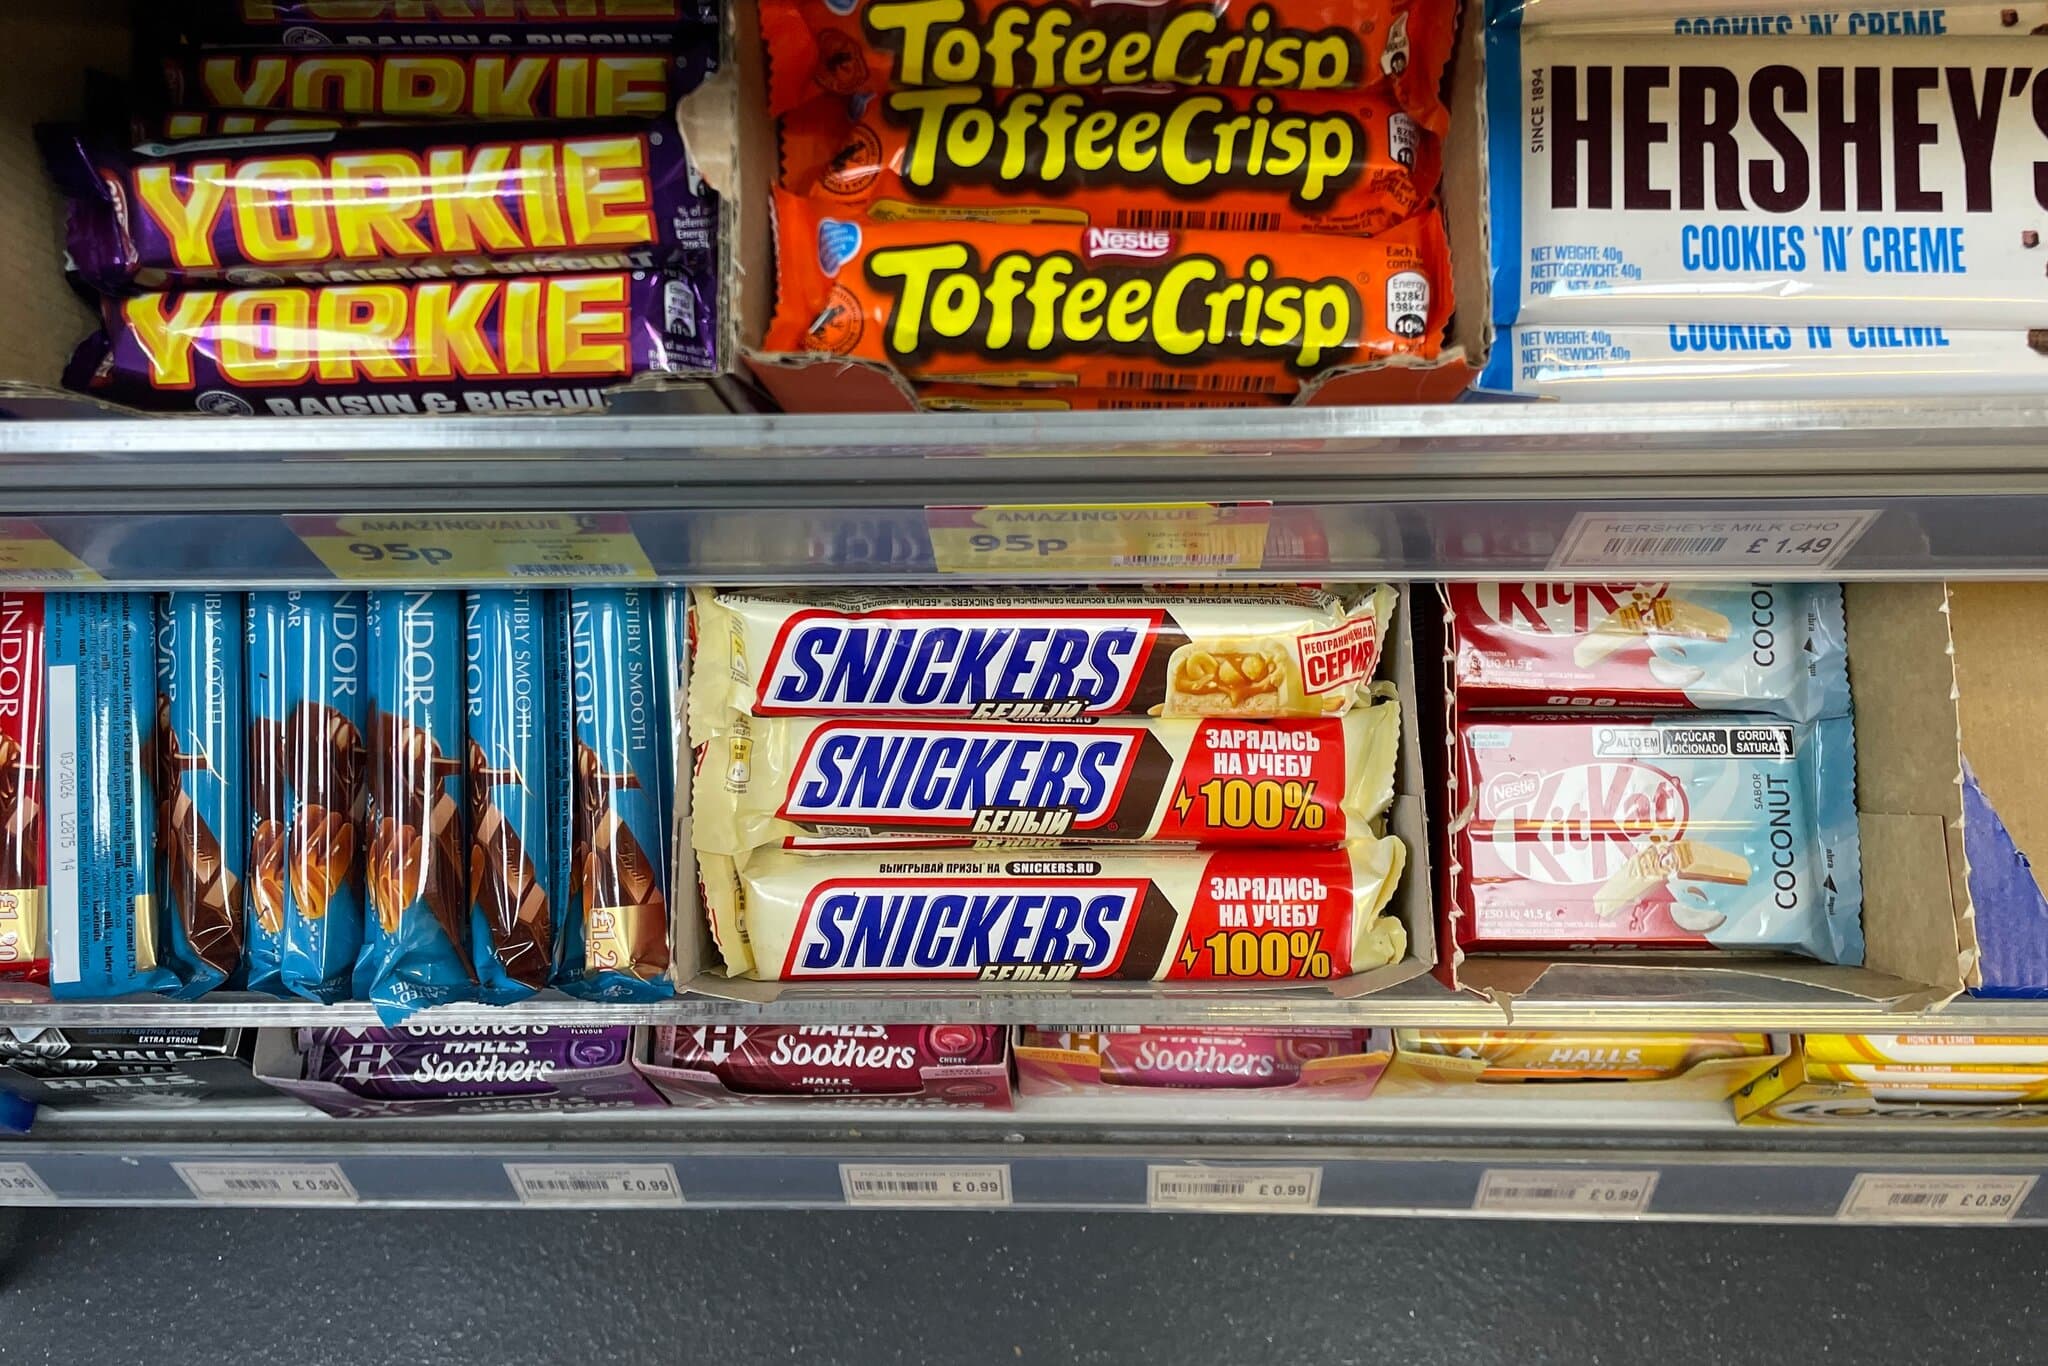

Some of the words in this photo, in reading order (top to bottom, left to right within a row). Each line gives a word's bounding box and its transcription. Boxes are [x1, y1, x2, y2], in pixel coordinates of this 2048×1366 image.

[1531, 68, 1544, 102] 1894
[1531, 106, 1545, 153] SINCE
[135, 136, 653, 267] YORKIE
[1531, 246, 1551, 261] NET
[1555, 245, 1600, 262] WEIGHT:
[1602, 246, 1623, 264] 40g
[1682, 224, 1806, 273] COOKIES
[1814, 226, 1854, 273] 'N'
[1863, 226, 1966, 274] CREME
[1621, 264, 1642, 280] 40g
[122, 272, 634, 389] YORKIE
[1521, 331, 1541, 346] NET
[1544, 331, 1588, 346] WEIGHT:
[264, 396, 418, 418] RAISIN
[421, 393, 458, 414] &
[462, 388, 609, 413] BISCUI
[1731, 522, 1783, 533] MILK
[1788, 521, 1841, 532] CHO
[347, 542, 454, 566] 95p
[968, 533, 1068, 556] 95p
[1746, 537, 1769, 554] £
[1775, 537, 1833, 555] 1.49
[287, 591, 301, 629] BAR
[466, 594, 483, 717] INDOR
[572, 601, 595, 724] INDOR
[774, 626, 1138, 707] SNICKERS
[121, 660, 132, 691] crystals
[514, 651, 532, 739] SMOOTH
[629, 661, 646, 750] SMOOTH
[1206, 729, 1320, 753] ЗАРЯДИСЬ
[1616, 737, 1642, 748] ALTO
[1643, 737, 1658, 748] EM
[1674, 730, 1716, 744] AÇÚCAR
[1737, 730, 1788, 742] GORDURA
[1665, 743, 1727, 755] ADICIONADO
[59, 752, 74, 799] 03/2026
[798, 735, 1122, 813] SNICKERS
[1214, 753, 1242, 775] НА
[1247, 752, 1312, 777] УЧЕБУ
[1200, 778, 1325, 830] 100%
[1755, 773, 1764, 810] SABOR
[971, 810, 1074, 835] БЕЛЫЙ
[1513, 765, 1677, 885] KitKat
[1767, 773, 1798, 909] COCONUT
[879, 862, 945, 874] ВЫИГРЫВАЙ
[946, 863, 984, 874] ПРИЗЫ
[986, 863, 1001, 874] НА
[1012, 862, 1095, 874] SNICKERS.RU
[1210, 876, 1328, 902] ЗАРЯДИСЬ
[127, 897, 135, 914] with
[1219, 905, 1249, 927] НА
[1253, 904, 1319, 928] УЧЕБУ
[127, 918, 135, 951] caramel
[802, 893, 1126, 968] SNICKERS
[1206, 930, 1330, 979] 100%
[978, 963, 1081, 982] БЕЛЫЙ
[139, 1036, 164, 1044] EXTRA
[166, 1036, 198, 1044] STRONG
[770, 1034, 916, 1070] Soothers
[939, 1056, 969, 1064] CHERRY
[1135, 1040, 1274, 1077] Soothers
[1550, 1048, 1641, 1063] HALLS
[413, 1053, 556, 1084] Soothers
[305, 1180, 340, 1191] 0.99
[622, 1180, 633, 1192] £
[637, 1180, 670, 1192] 0.99
[952, 1182, 962, 1192] £
[966, 1182, 998, 1193] 0.99
[1258, 1184, 1269, 1196] £
[1273, 1184, 1306, 1196] 0.99
[1604, 1189, 1640, 1201] 0.99
[1959, 1194, 1974, 1206] £
[1975, 1194, 2012, 1207] 0.99
